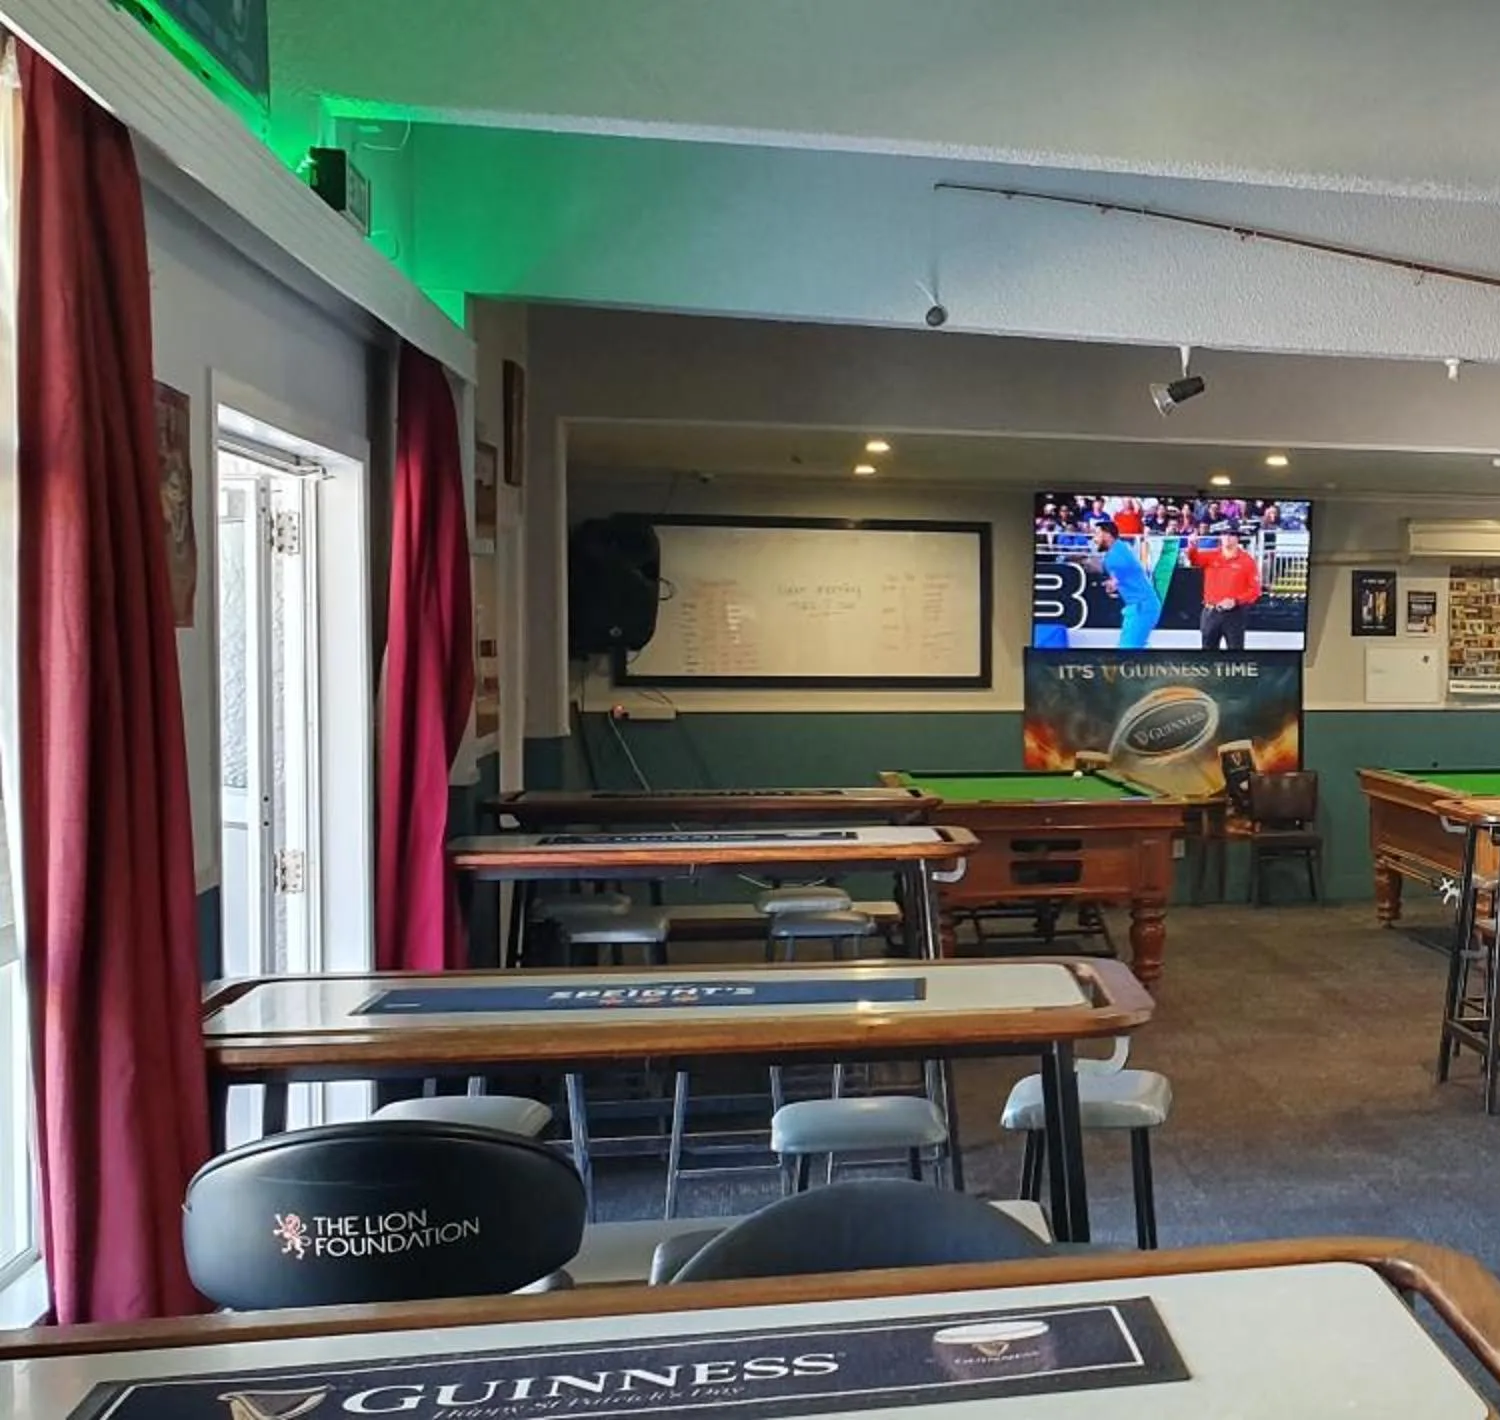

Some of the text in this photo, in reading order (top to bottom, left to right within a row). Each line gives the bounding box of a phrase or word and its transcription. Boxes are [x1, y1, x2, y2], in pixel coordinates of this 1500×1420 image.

[1058, 661, 1260, 680] IT'S GUINNESS TIME
[313, 1208, 427, 1237] THE LION
[315, 1216, 480, 1257] FOUNDATION
[342, 1353, 840, 1414] GUINNESS
